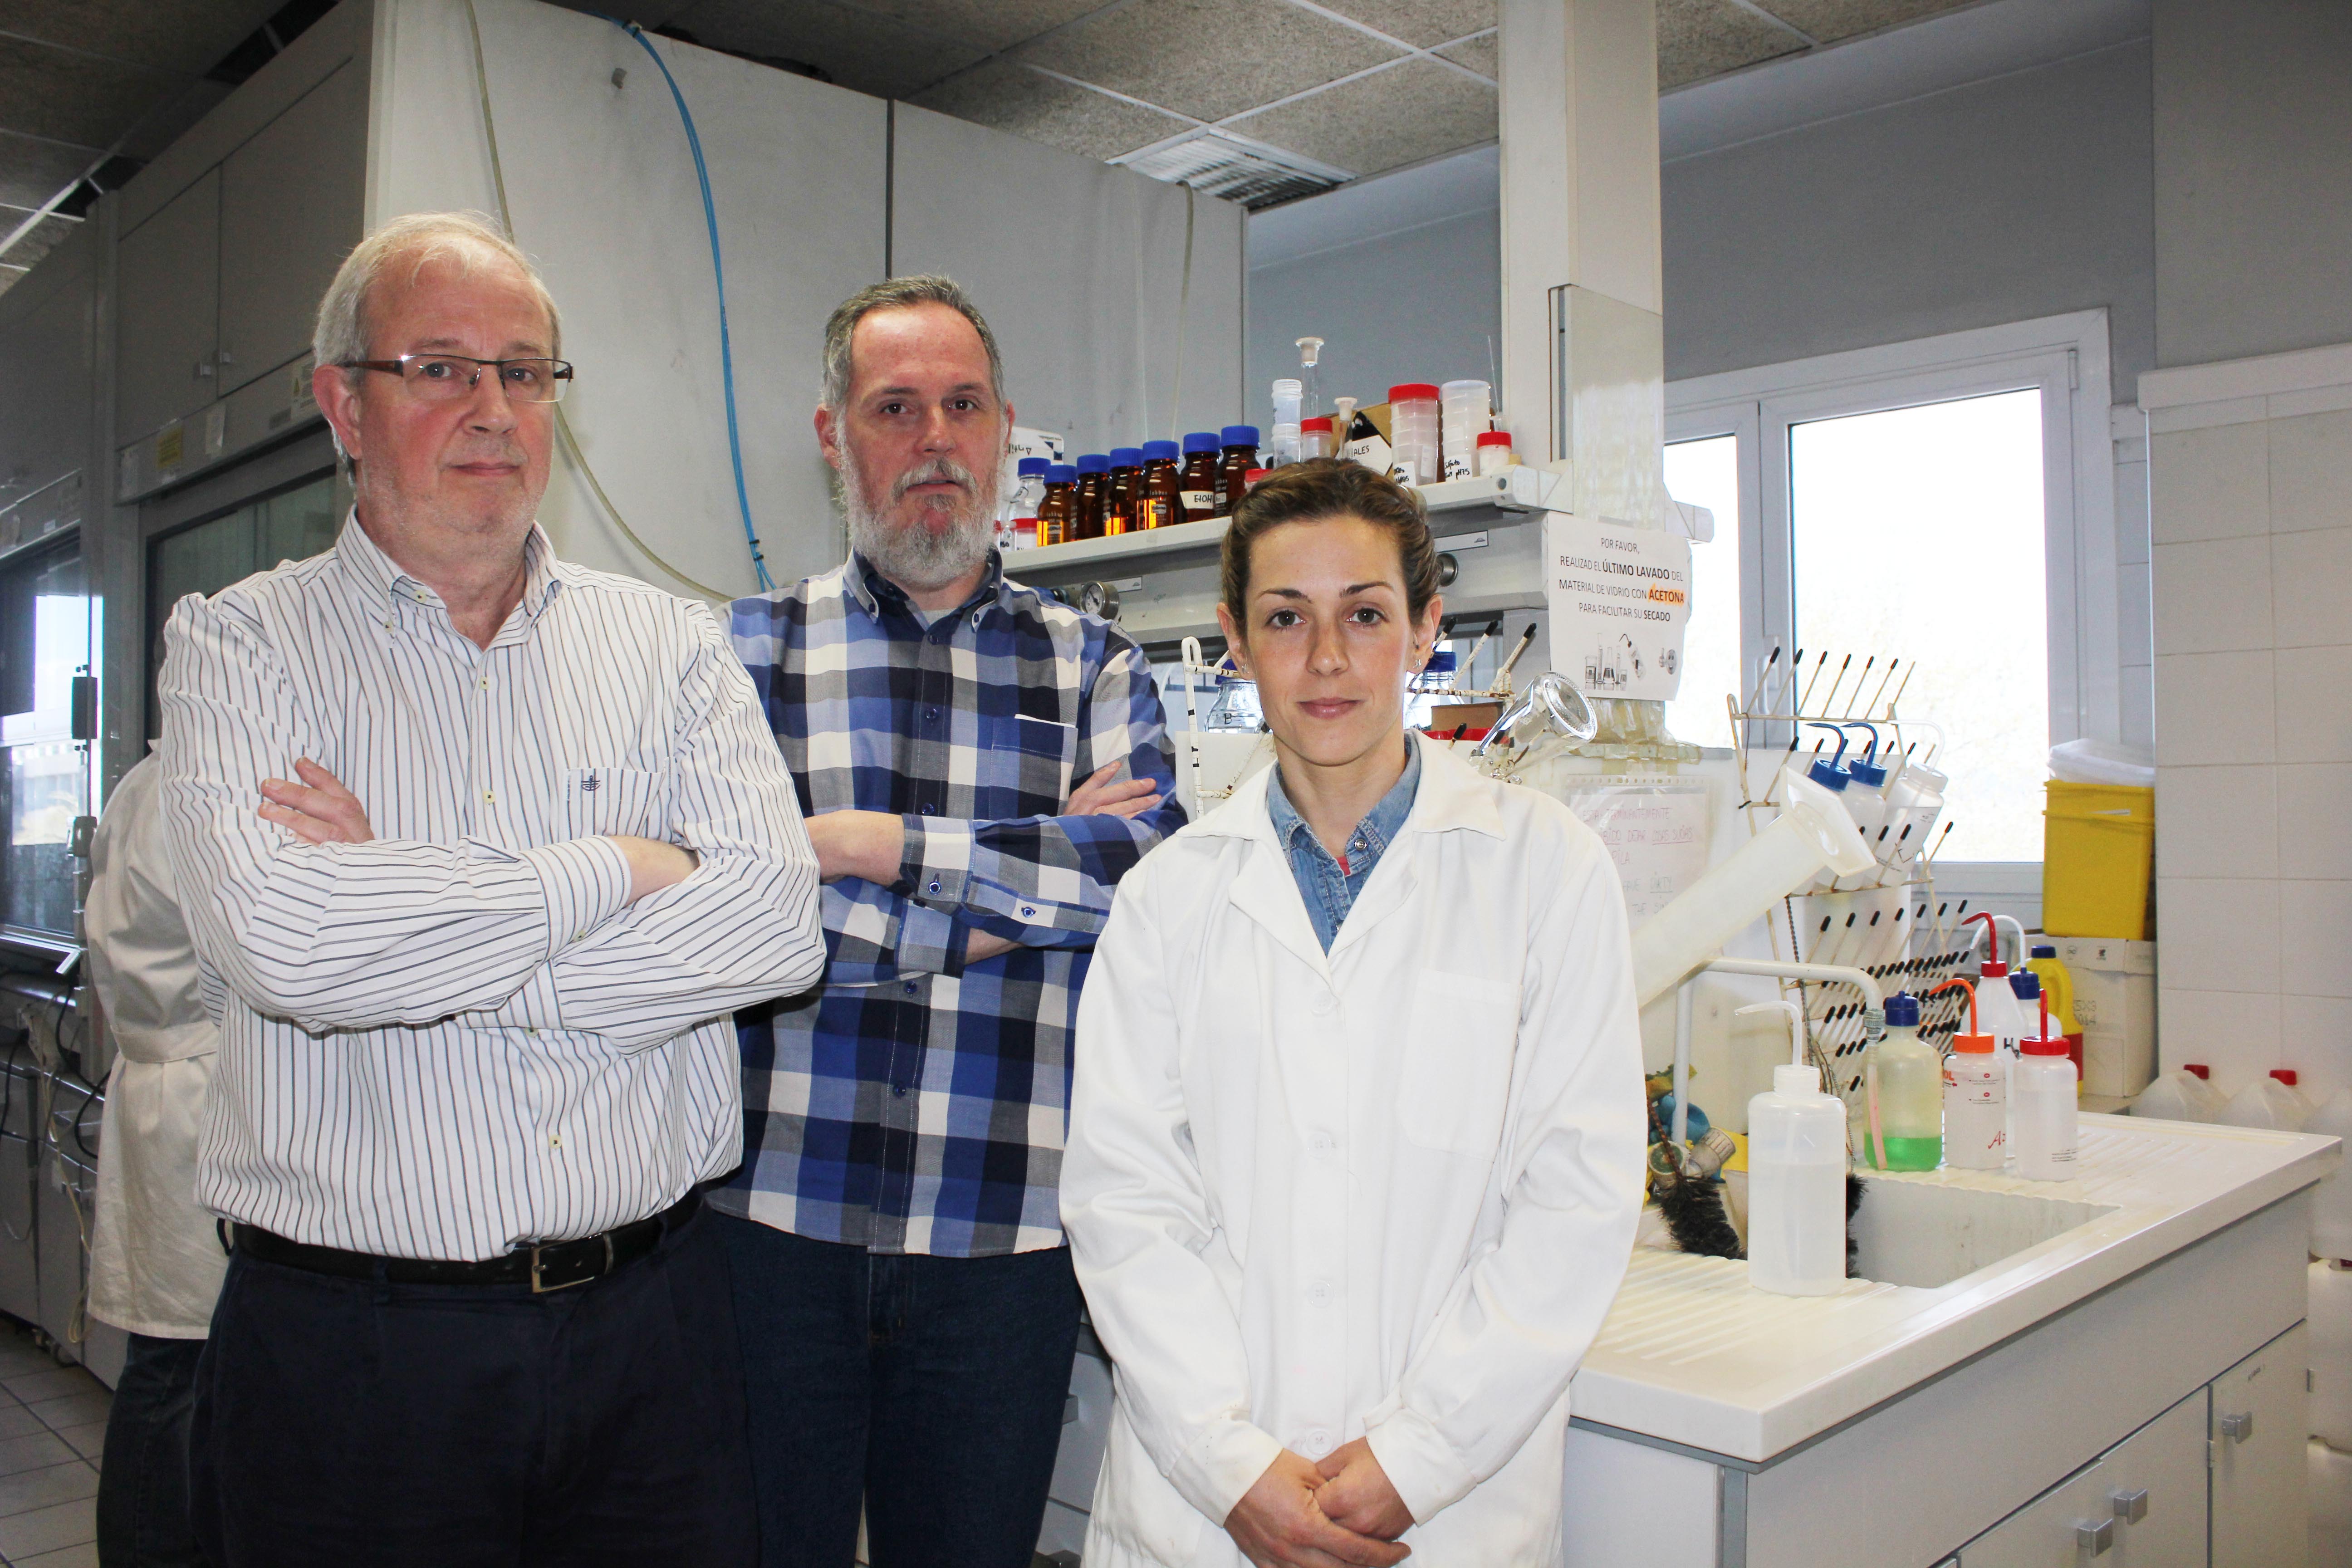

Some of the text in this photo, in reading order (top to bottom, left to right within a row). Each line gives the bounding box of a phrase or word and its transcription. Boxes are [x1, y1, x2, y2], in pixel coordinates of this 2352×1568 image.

[1601, 538, 1640, 554] POR FAVOR,
[1560, 556, 1683, 581] REALIZAD EL ÚLTIMO LAVADO DEL
[1559, 579, 1684, 603] MATERIAL DE VIDRIO CON ACETONA
[1579, 603, 1671, 622] PARA FACILITAR SU SECADO
